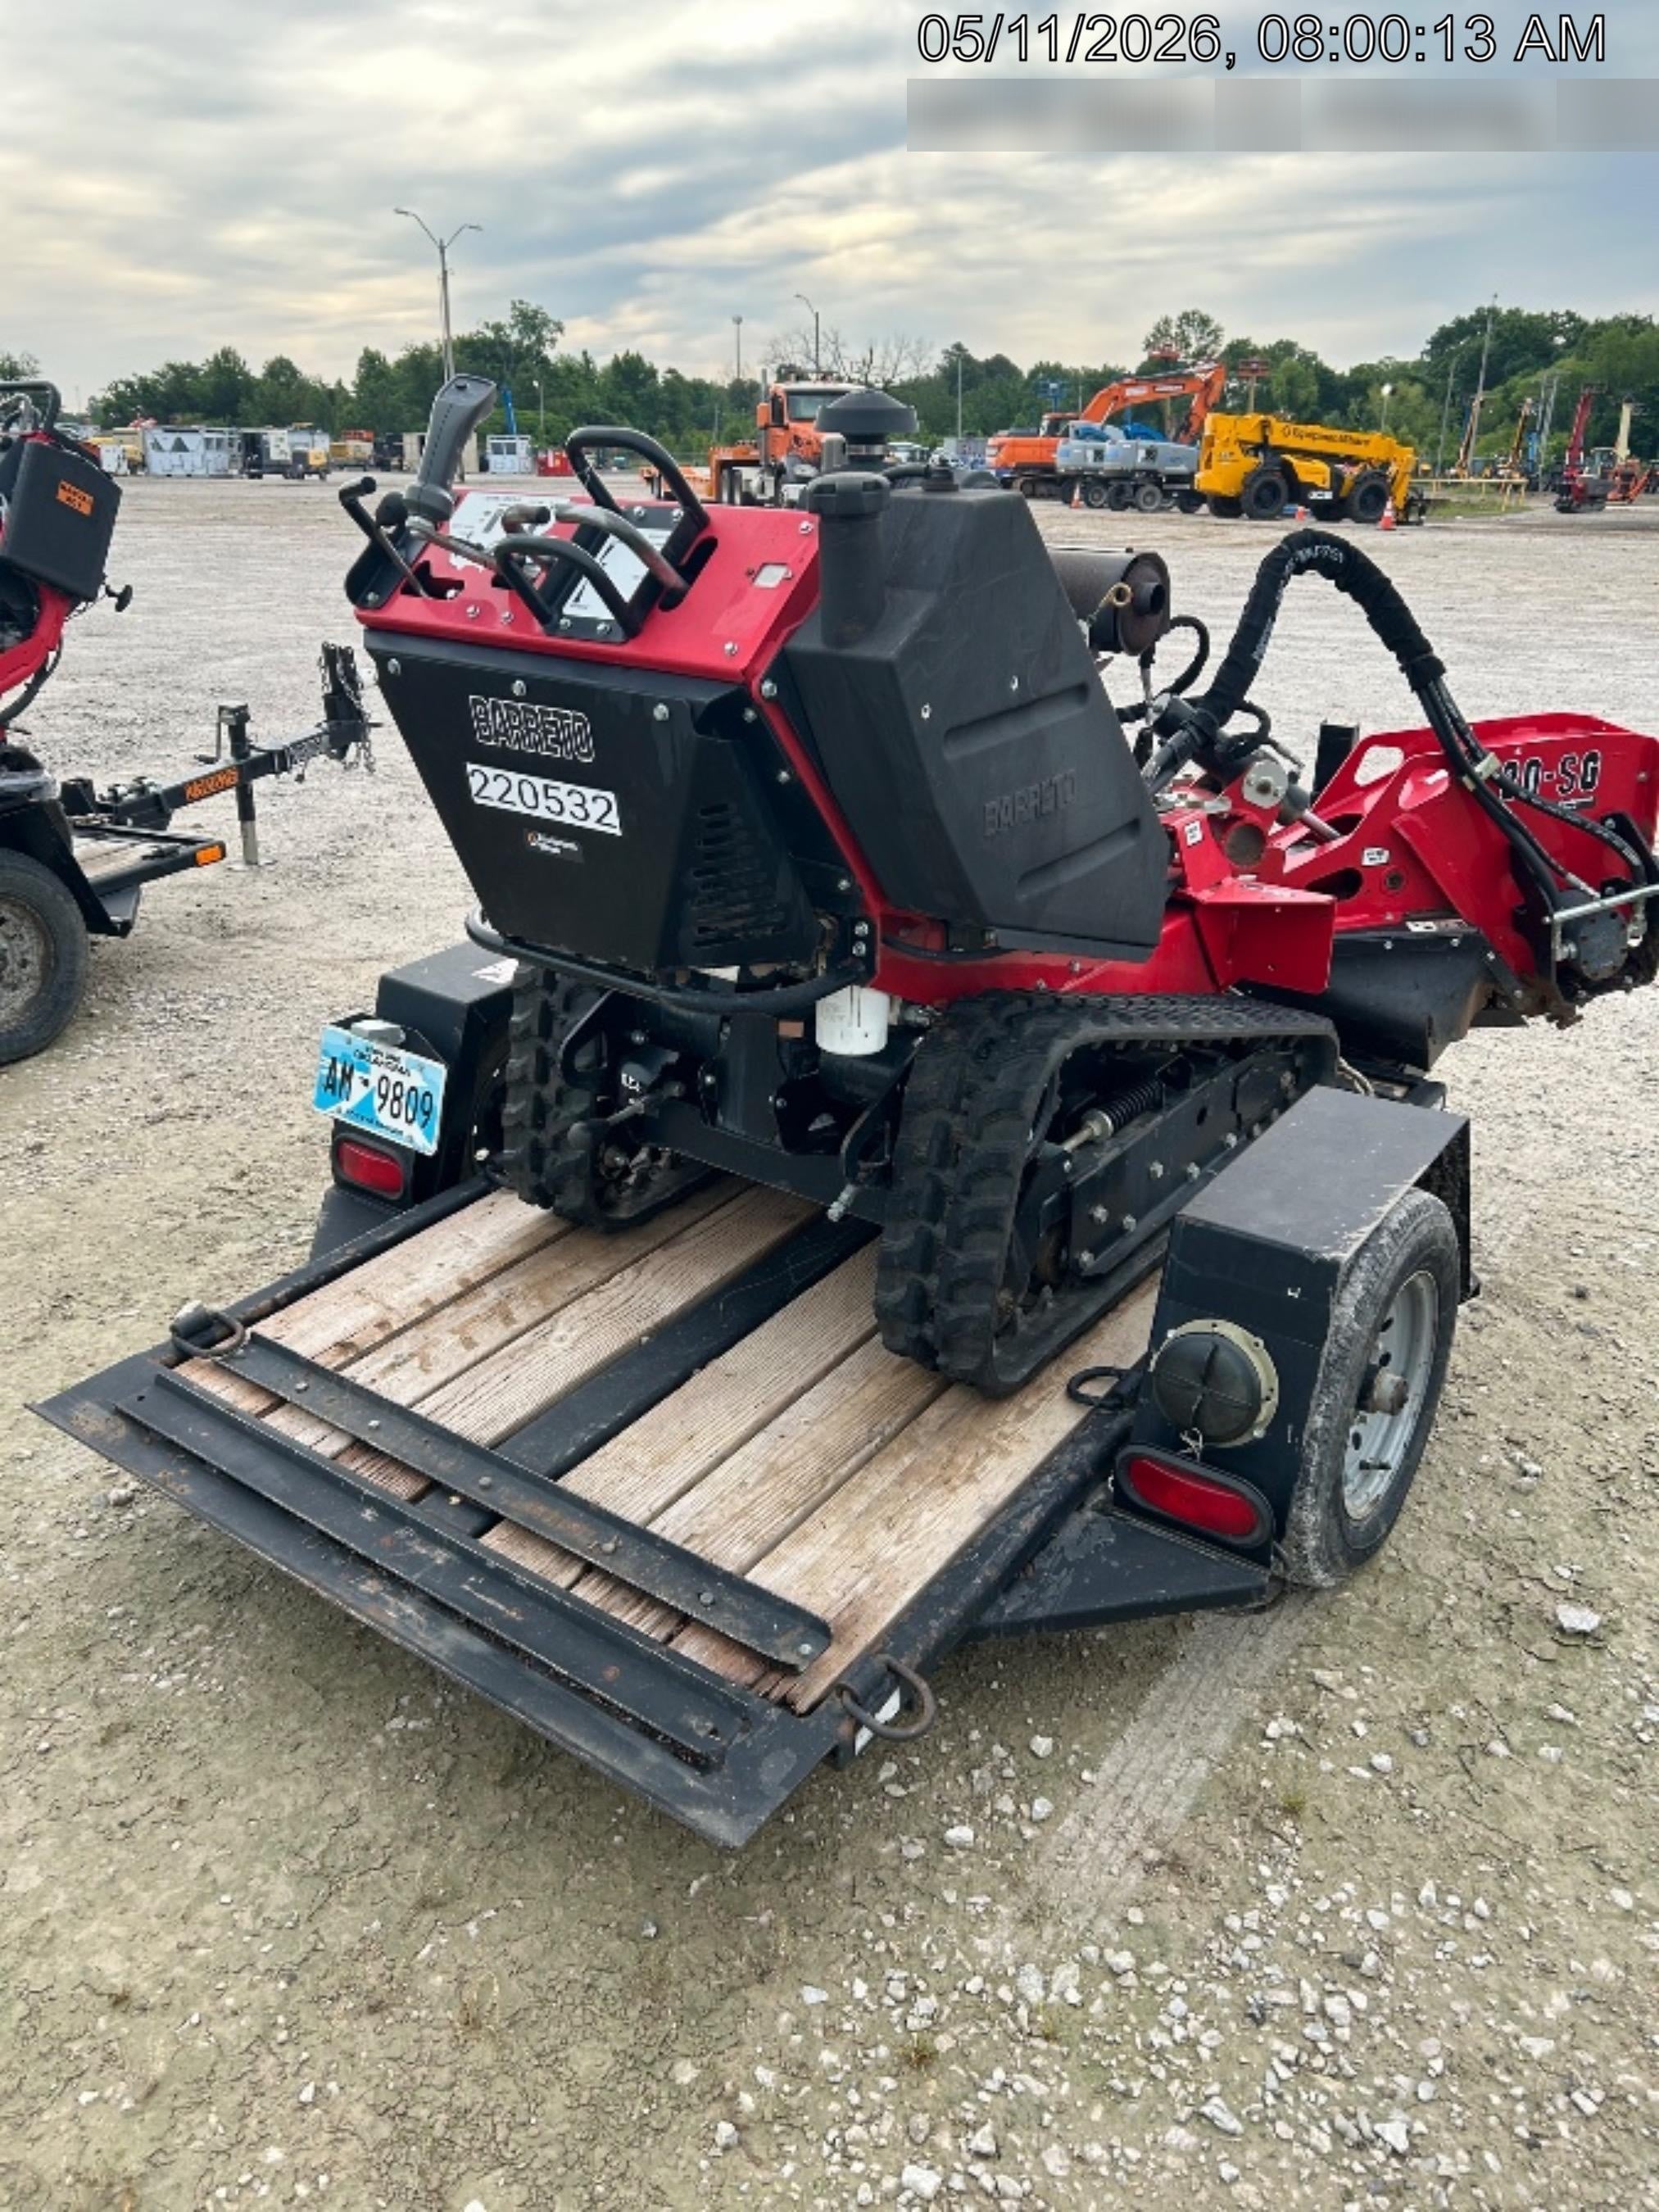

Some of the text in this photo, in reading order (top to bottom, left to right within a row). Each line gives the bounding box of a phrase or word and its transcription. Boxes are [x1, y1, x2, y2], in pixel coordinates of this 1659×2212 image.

[469, 695, 595, 763] BARRETO
[469, 768, 619, 829] 220532
[377, 1074, 433, 1130] 9809
